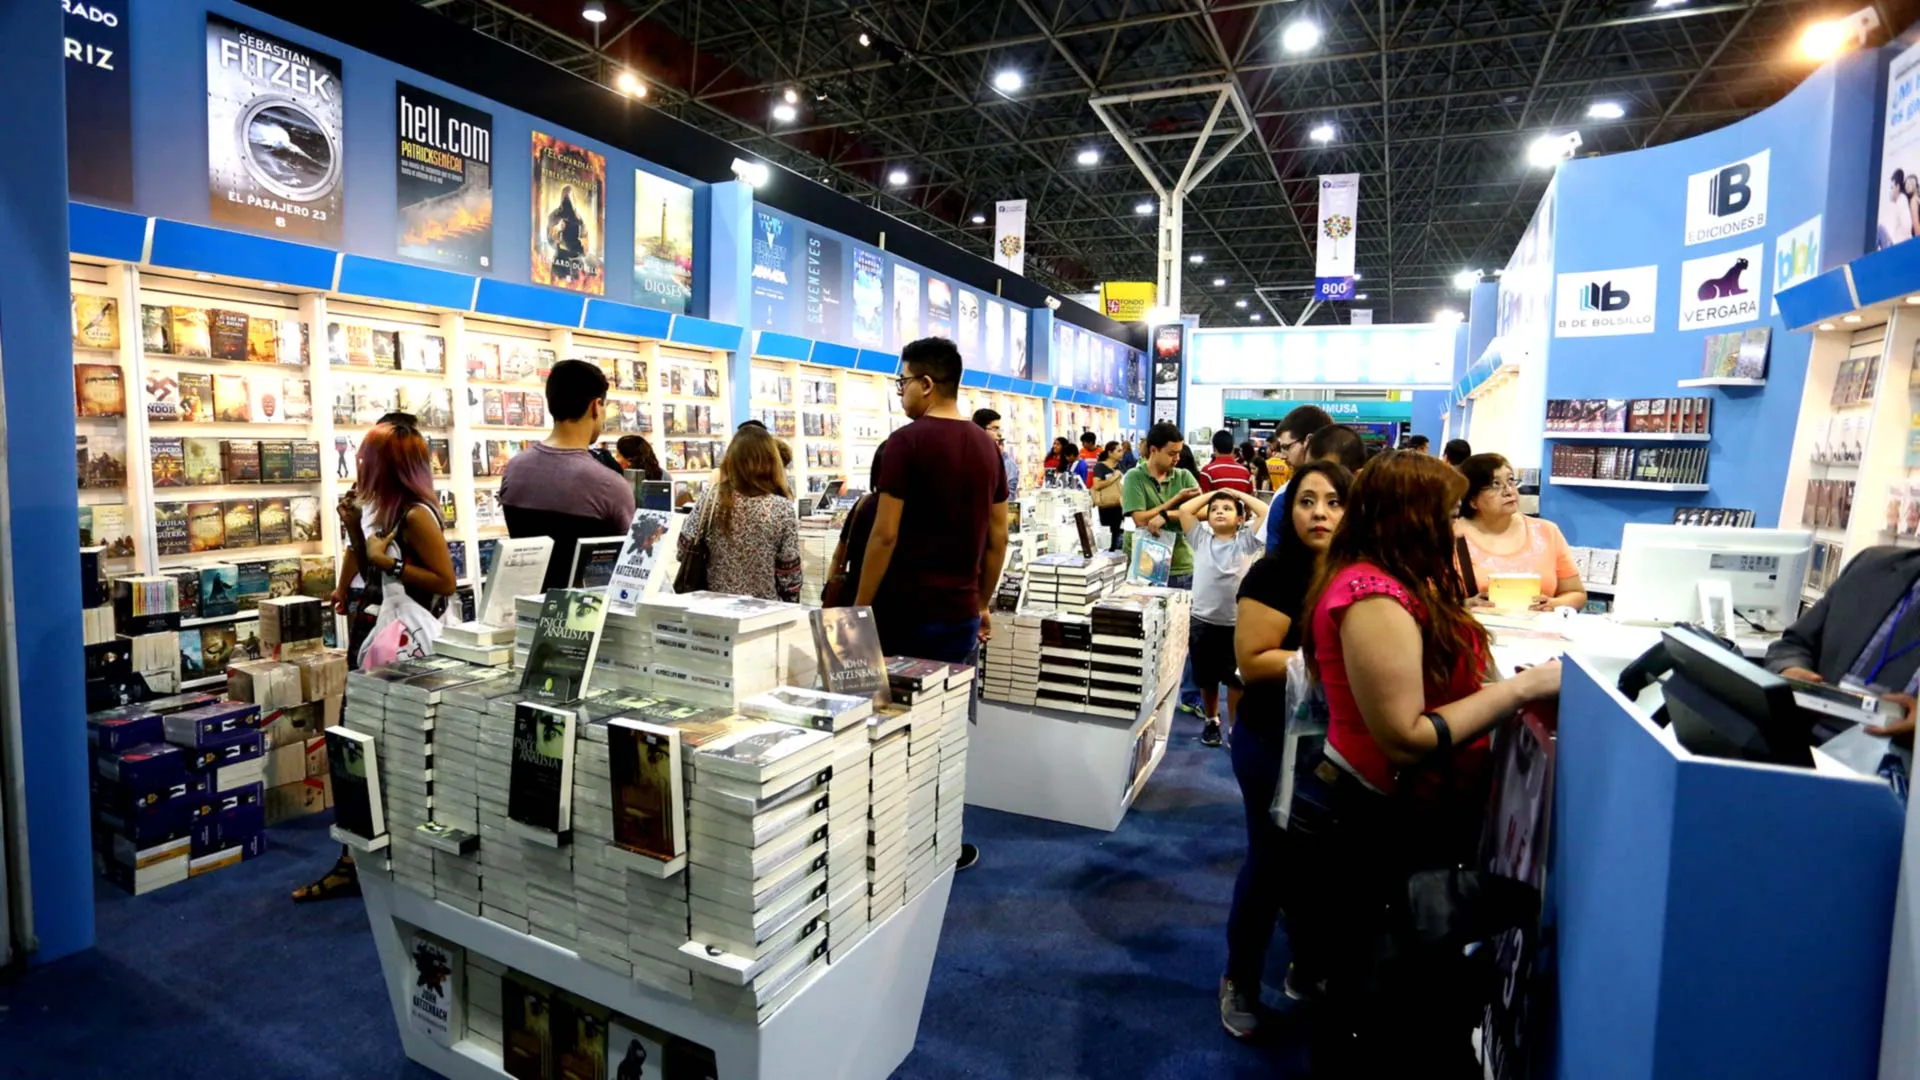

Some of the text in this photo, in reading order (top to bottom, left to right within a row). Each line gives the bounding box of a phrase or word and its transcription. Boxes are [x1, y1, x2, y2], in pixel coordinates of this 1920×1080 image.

[239, 33, 310, 66] SEBASTIAN
[220, 38, 331, 101] FITZEK
[400, 95, 489, 164] hell.com
[228, 191, 327, 221] EL PASAJERO 23
[1688, 213, 1764, 242] EDICIONES B
[644, 279, 683, 298] DIOSES
[806, 238, 821, 324] SEVENEVES
[1321, 282, 1346, 294] 800
[1558, 315, 1652, 328] B DE BOLSILLO
[1684, 300, 1757, 322] VERGARA
[543, 628, 590, 641] ANALISTA
[843, 659, 868, 671] JOHN
[420, 989, 437, 1005] JOHN
